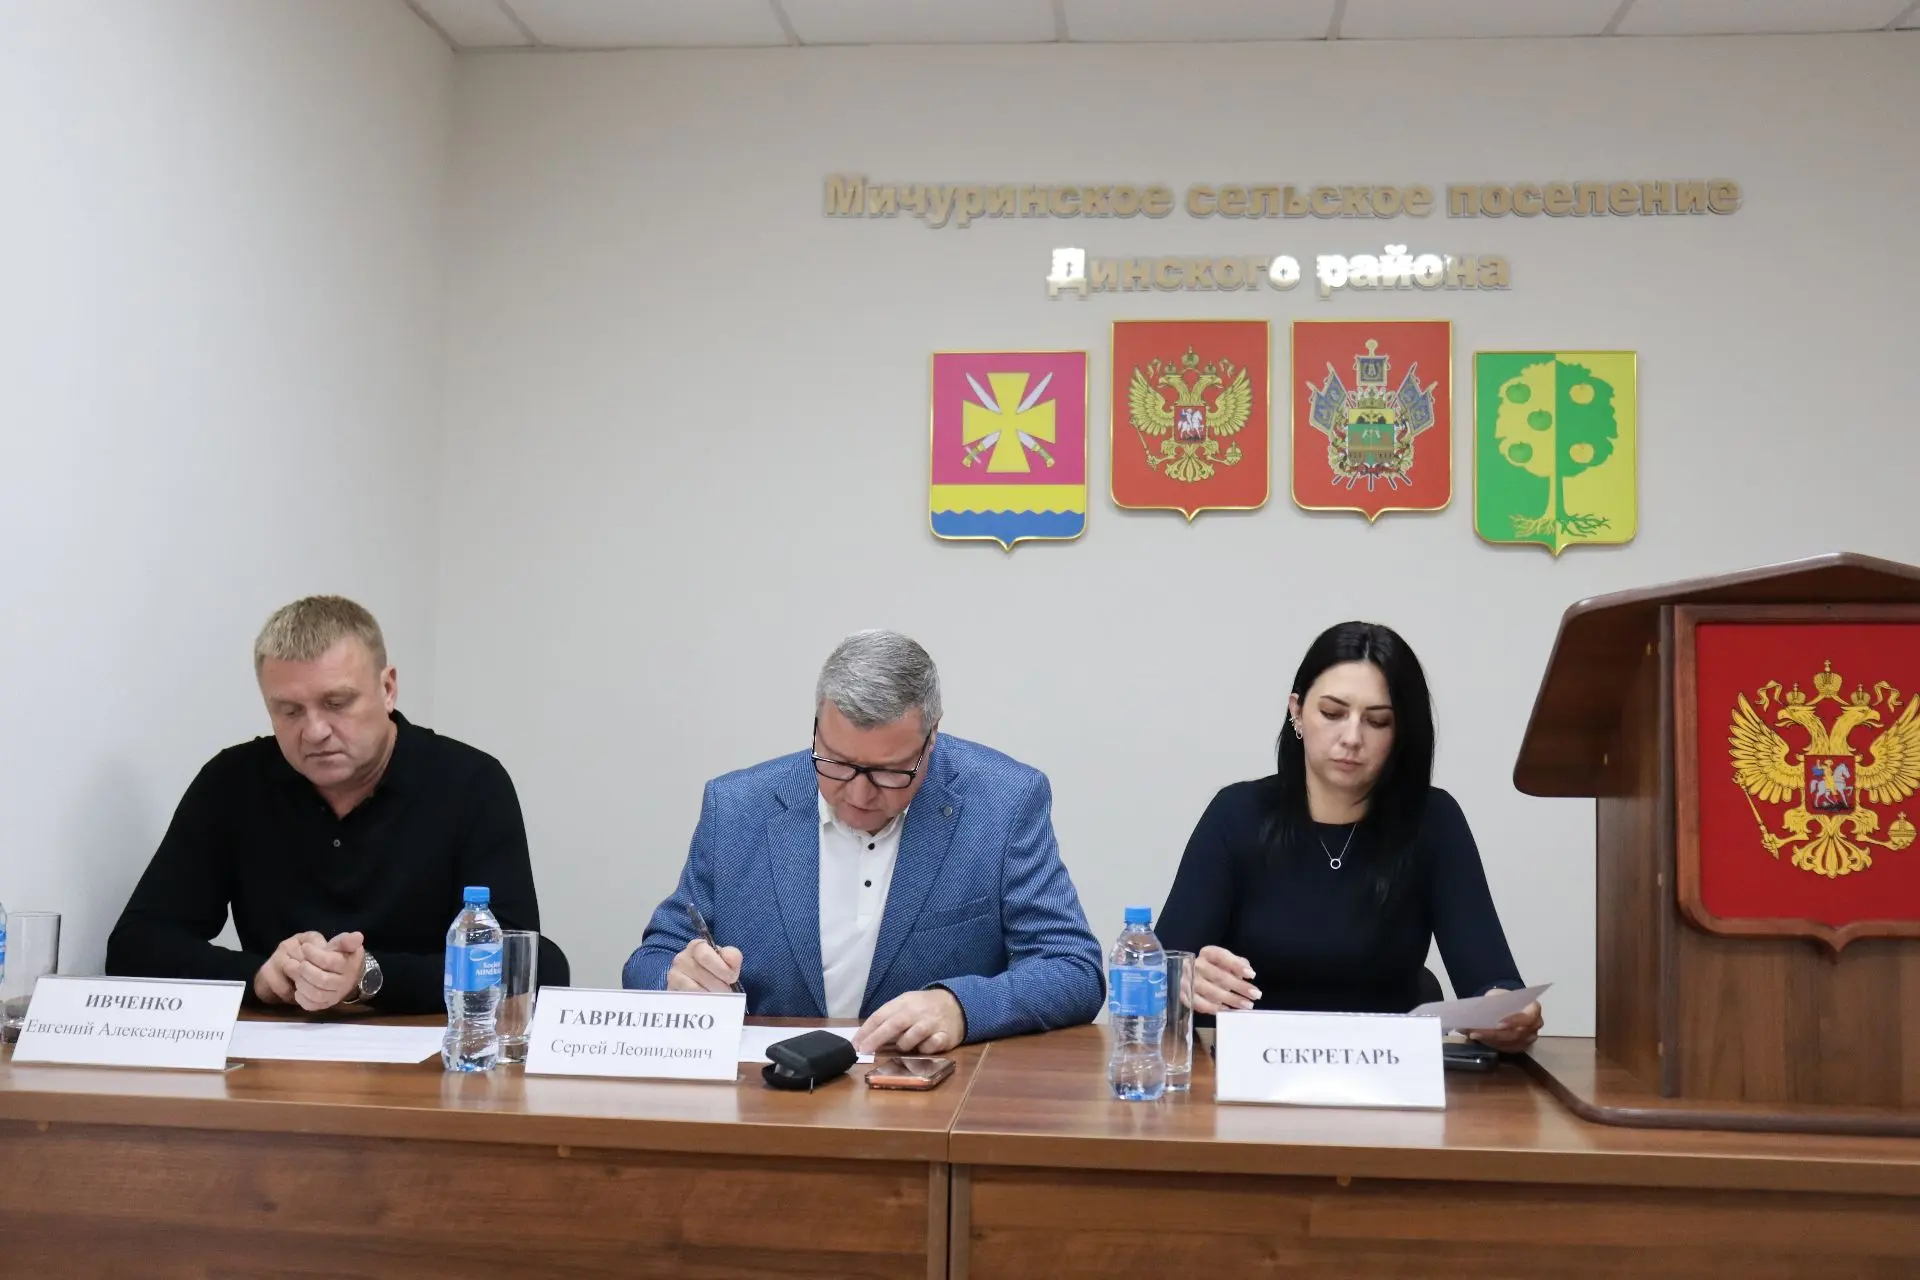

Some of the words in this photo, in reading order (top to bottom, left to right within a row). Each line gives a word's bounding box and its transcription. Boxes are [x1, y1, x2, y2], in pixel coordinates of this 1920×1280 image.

[824, 174, 1175, 229] Мичуринское
[1186, 183, 1437, 219] сельское
[1446, 179, 1744, 218] поселение
[1046, 247, 1301, 299] Динского
[1315, 244, 1512, 300] района
[85, 993, 183, 1012] ИВЧЕНКО
[25, 1018, 95, 1036] Евгений
[98, 1022, 226, 1044] Александрович
[559, 1008, 715, 1031] ГАВРИЛЕНКО
[551, 1038, 608, 1058] Сергей
[612, 1040, 713, 1060] Леонидович
[1262, 1047, 1401, 1066] СЕКРЕТАРЬ
